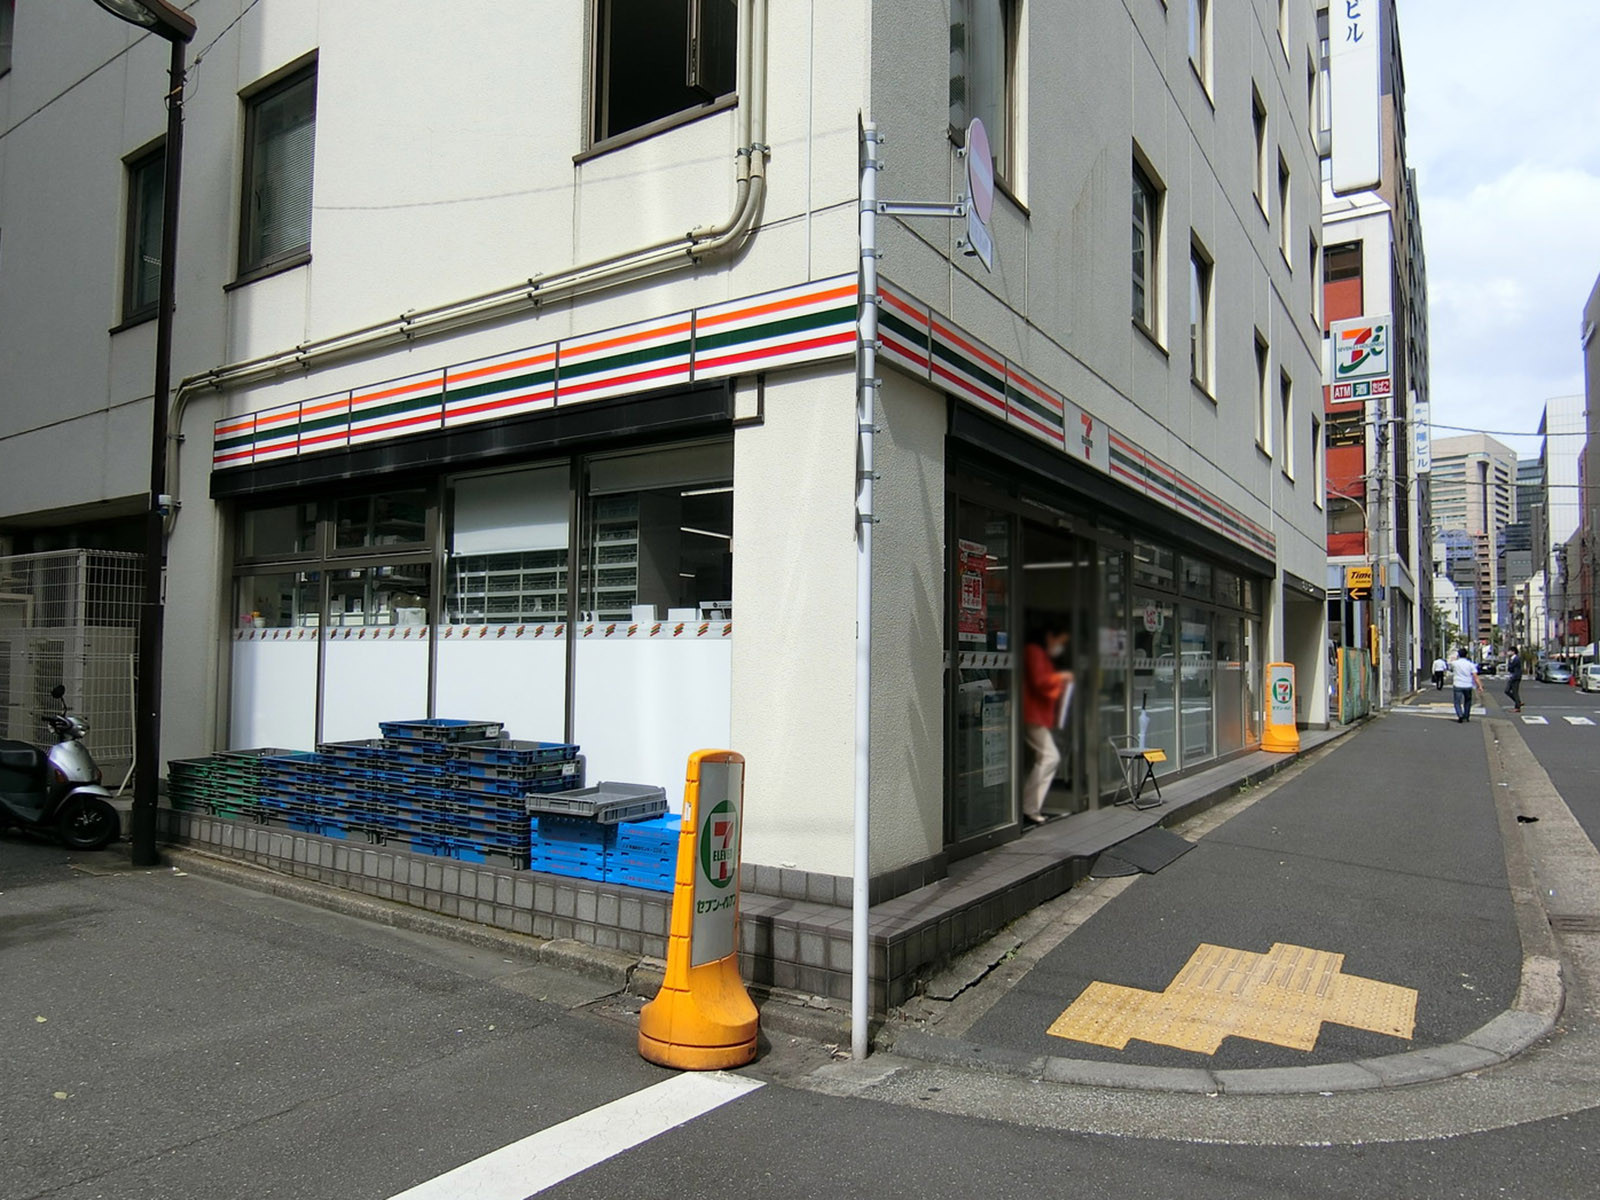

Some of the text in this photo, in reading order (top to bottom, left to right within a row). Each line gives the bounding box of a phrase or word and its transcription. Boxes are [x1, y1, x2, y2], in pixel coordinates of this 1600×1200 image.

[1345, 0, 1364, 43] ビル
[1334, 386, 1351, 398] ATM
[1278, 684, 1289, 701] 7
[714, 821, 734, 880] 7
